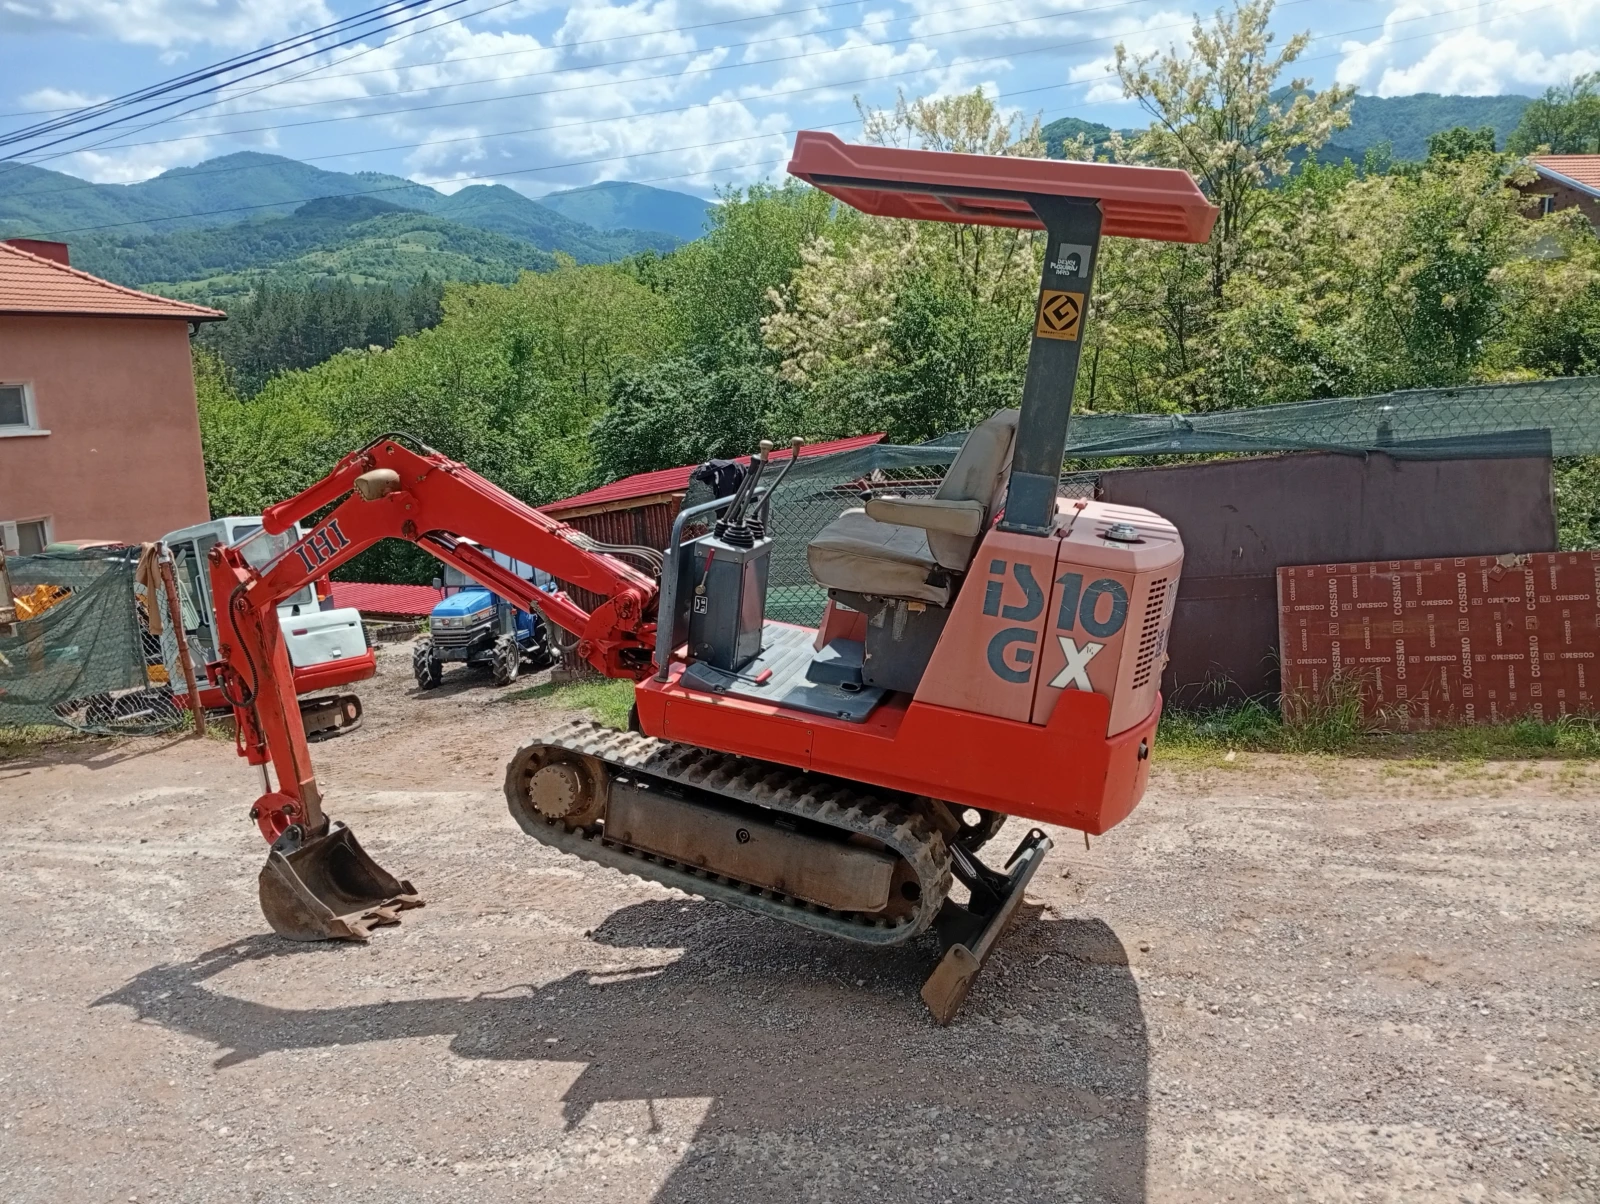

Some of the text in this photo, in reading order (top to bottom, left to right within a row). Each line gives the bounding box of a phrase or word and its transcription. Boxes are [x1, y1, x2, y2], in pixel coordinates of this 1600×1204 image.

[294, 518, 351, 575] IHI
[1329, 578, 1338, 618] COSSMO
[1392, 575, 1402, 615] COSSMO
[1457, 572, 1468, 613] COSSMO
[1525, 569, 1536, 611] COSSMO
[1332, 641, 1341, 680] COSSMO
[1396, 639, 1406, 680] COSSMO
[1461, 637, 1472, 679] COSSMO
[1529, 635, 1541, 677] COSSMO
